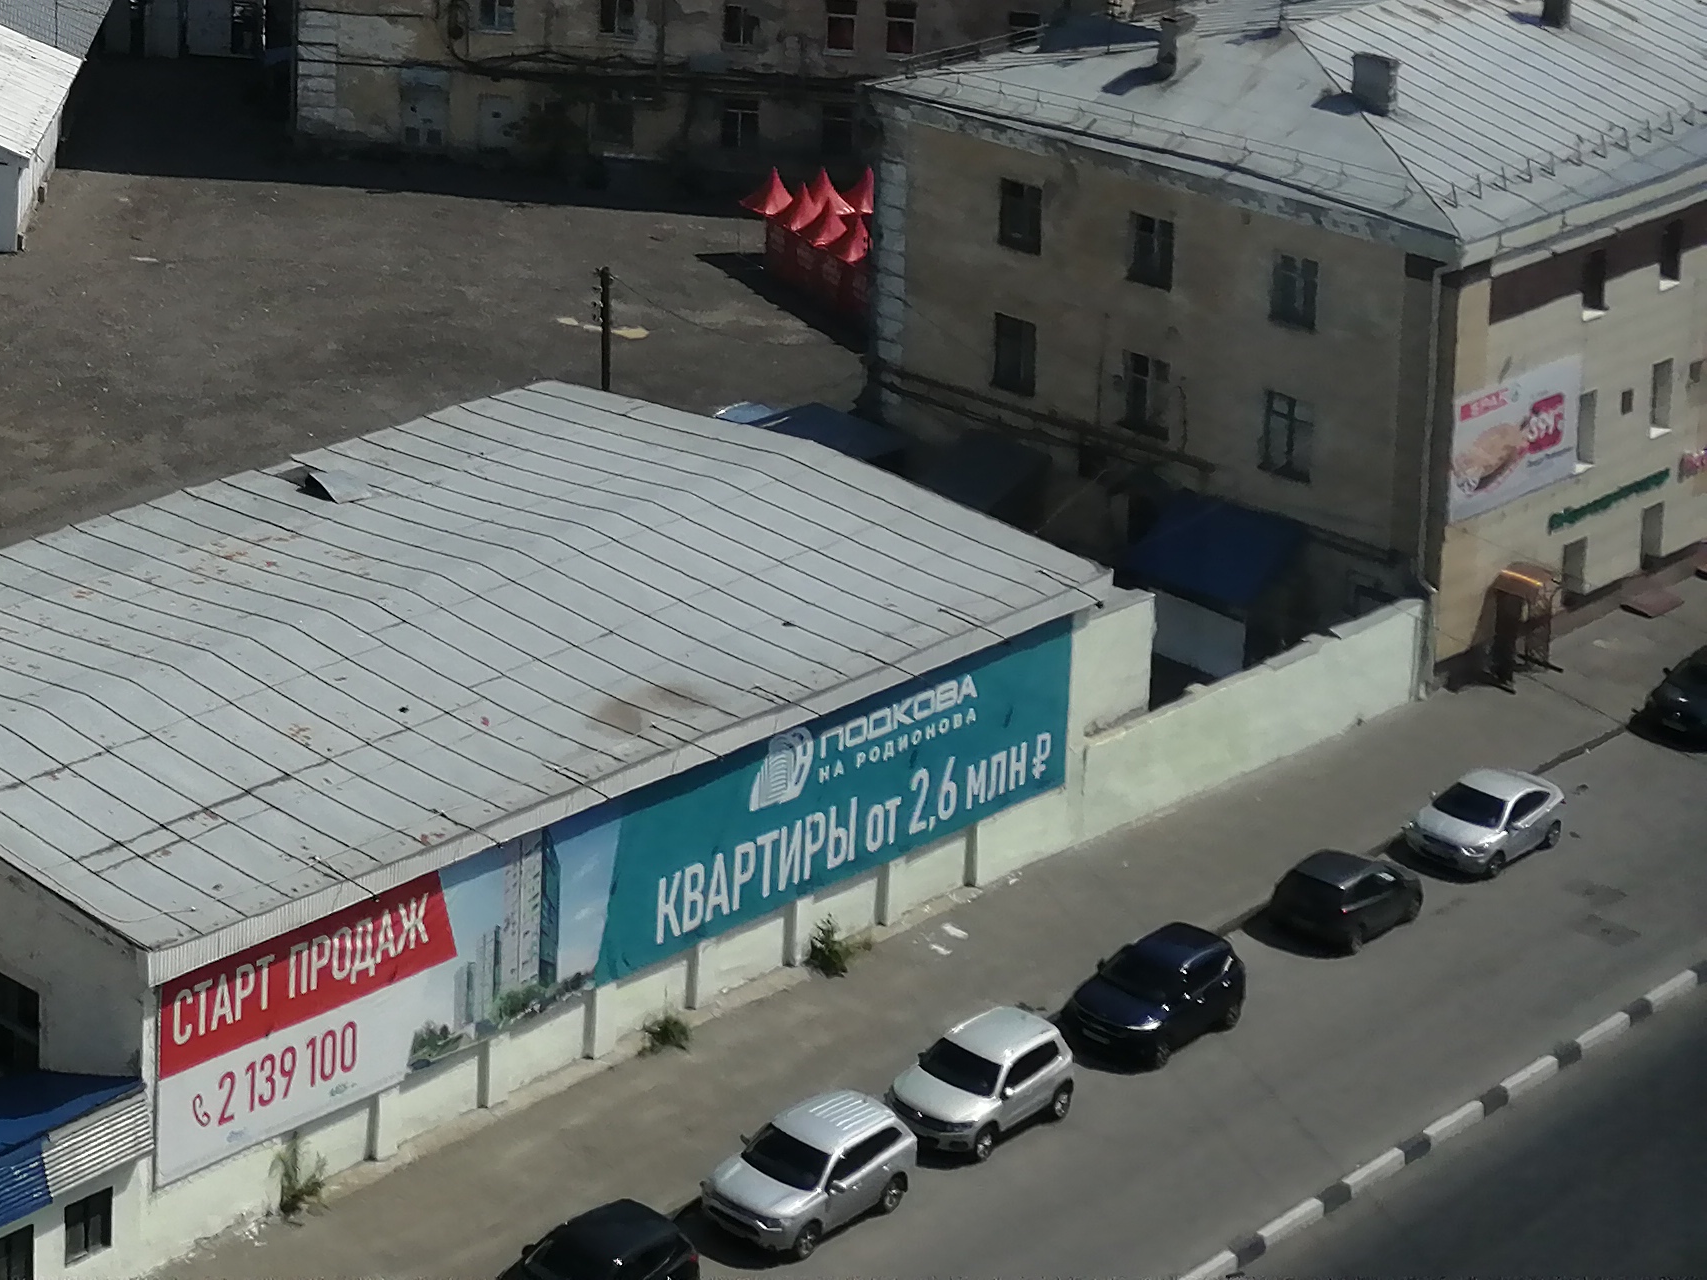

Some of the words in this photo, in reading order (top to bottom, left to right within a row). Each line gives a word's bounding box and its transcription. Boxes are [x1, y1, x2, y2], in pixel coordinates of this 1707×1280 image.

[818, 758, 845, 785] НА
[855, 707, 977, 770] РОДИОНОВА
[819, 673, 978, 759] ПОДКОВА
[655, 796, 859, 945] КВАРТИРЫ
[908, 755, 959, 835] 2,6
[171, 952, 277, 1046] СТАРТ
[286, 891, 430, 1000] ПРОДАЖ
[216, 1070, 237, 1127] 2
[243, 1045, 298, 1114] 139
[305, 1020, 358, 1089] 100
